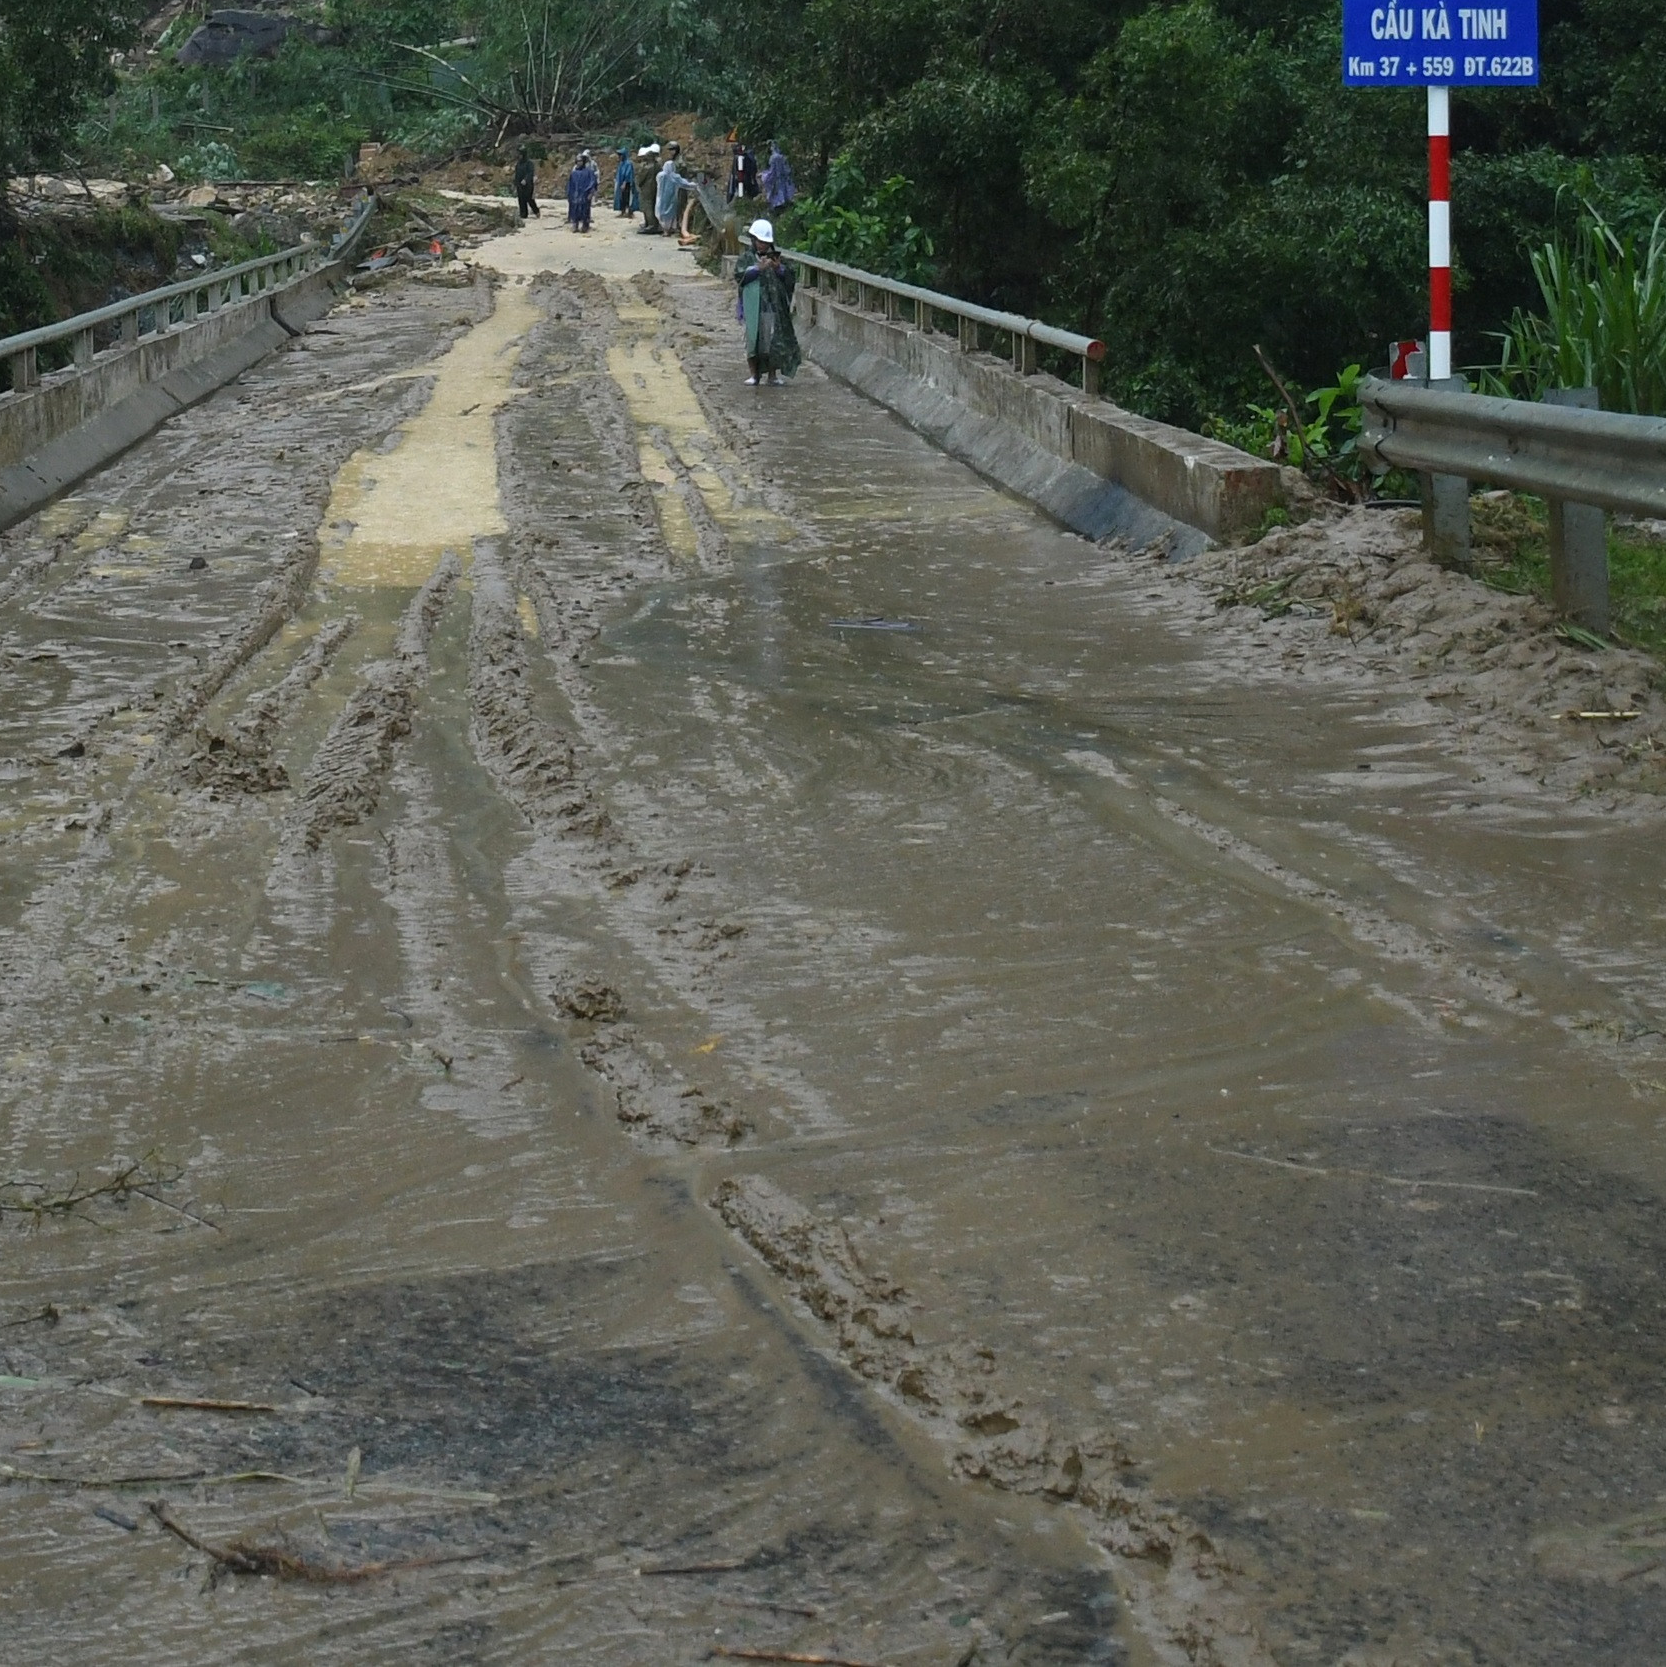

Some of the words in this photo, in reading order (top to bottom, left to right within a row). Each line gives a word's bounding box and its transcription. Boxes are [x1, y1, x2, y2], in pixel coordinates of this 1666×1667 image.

[1422, 1, 1451, 39] KÀ
[1458, 9, 1507, 39] TINH
[1348, 56, 1375, 76] Km
[1379, 56, 1400, 76] 37
[1406, 61, 1417, 76] +
[1422, 56, 1454, 76] 559
[1464, 56, 1534, 76] ĐT.622B
